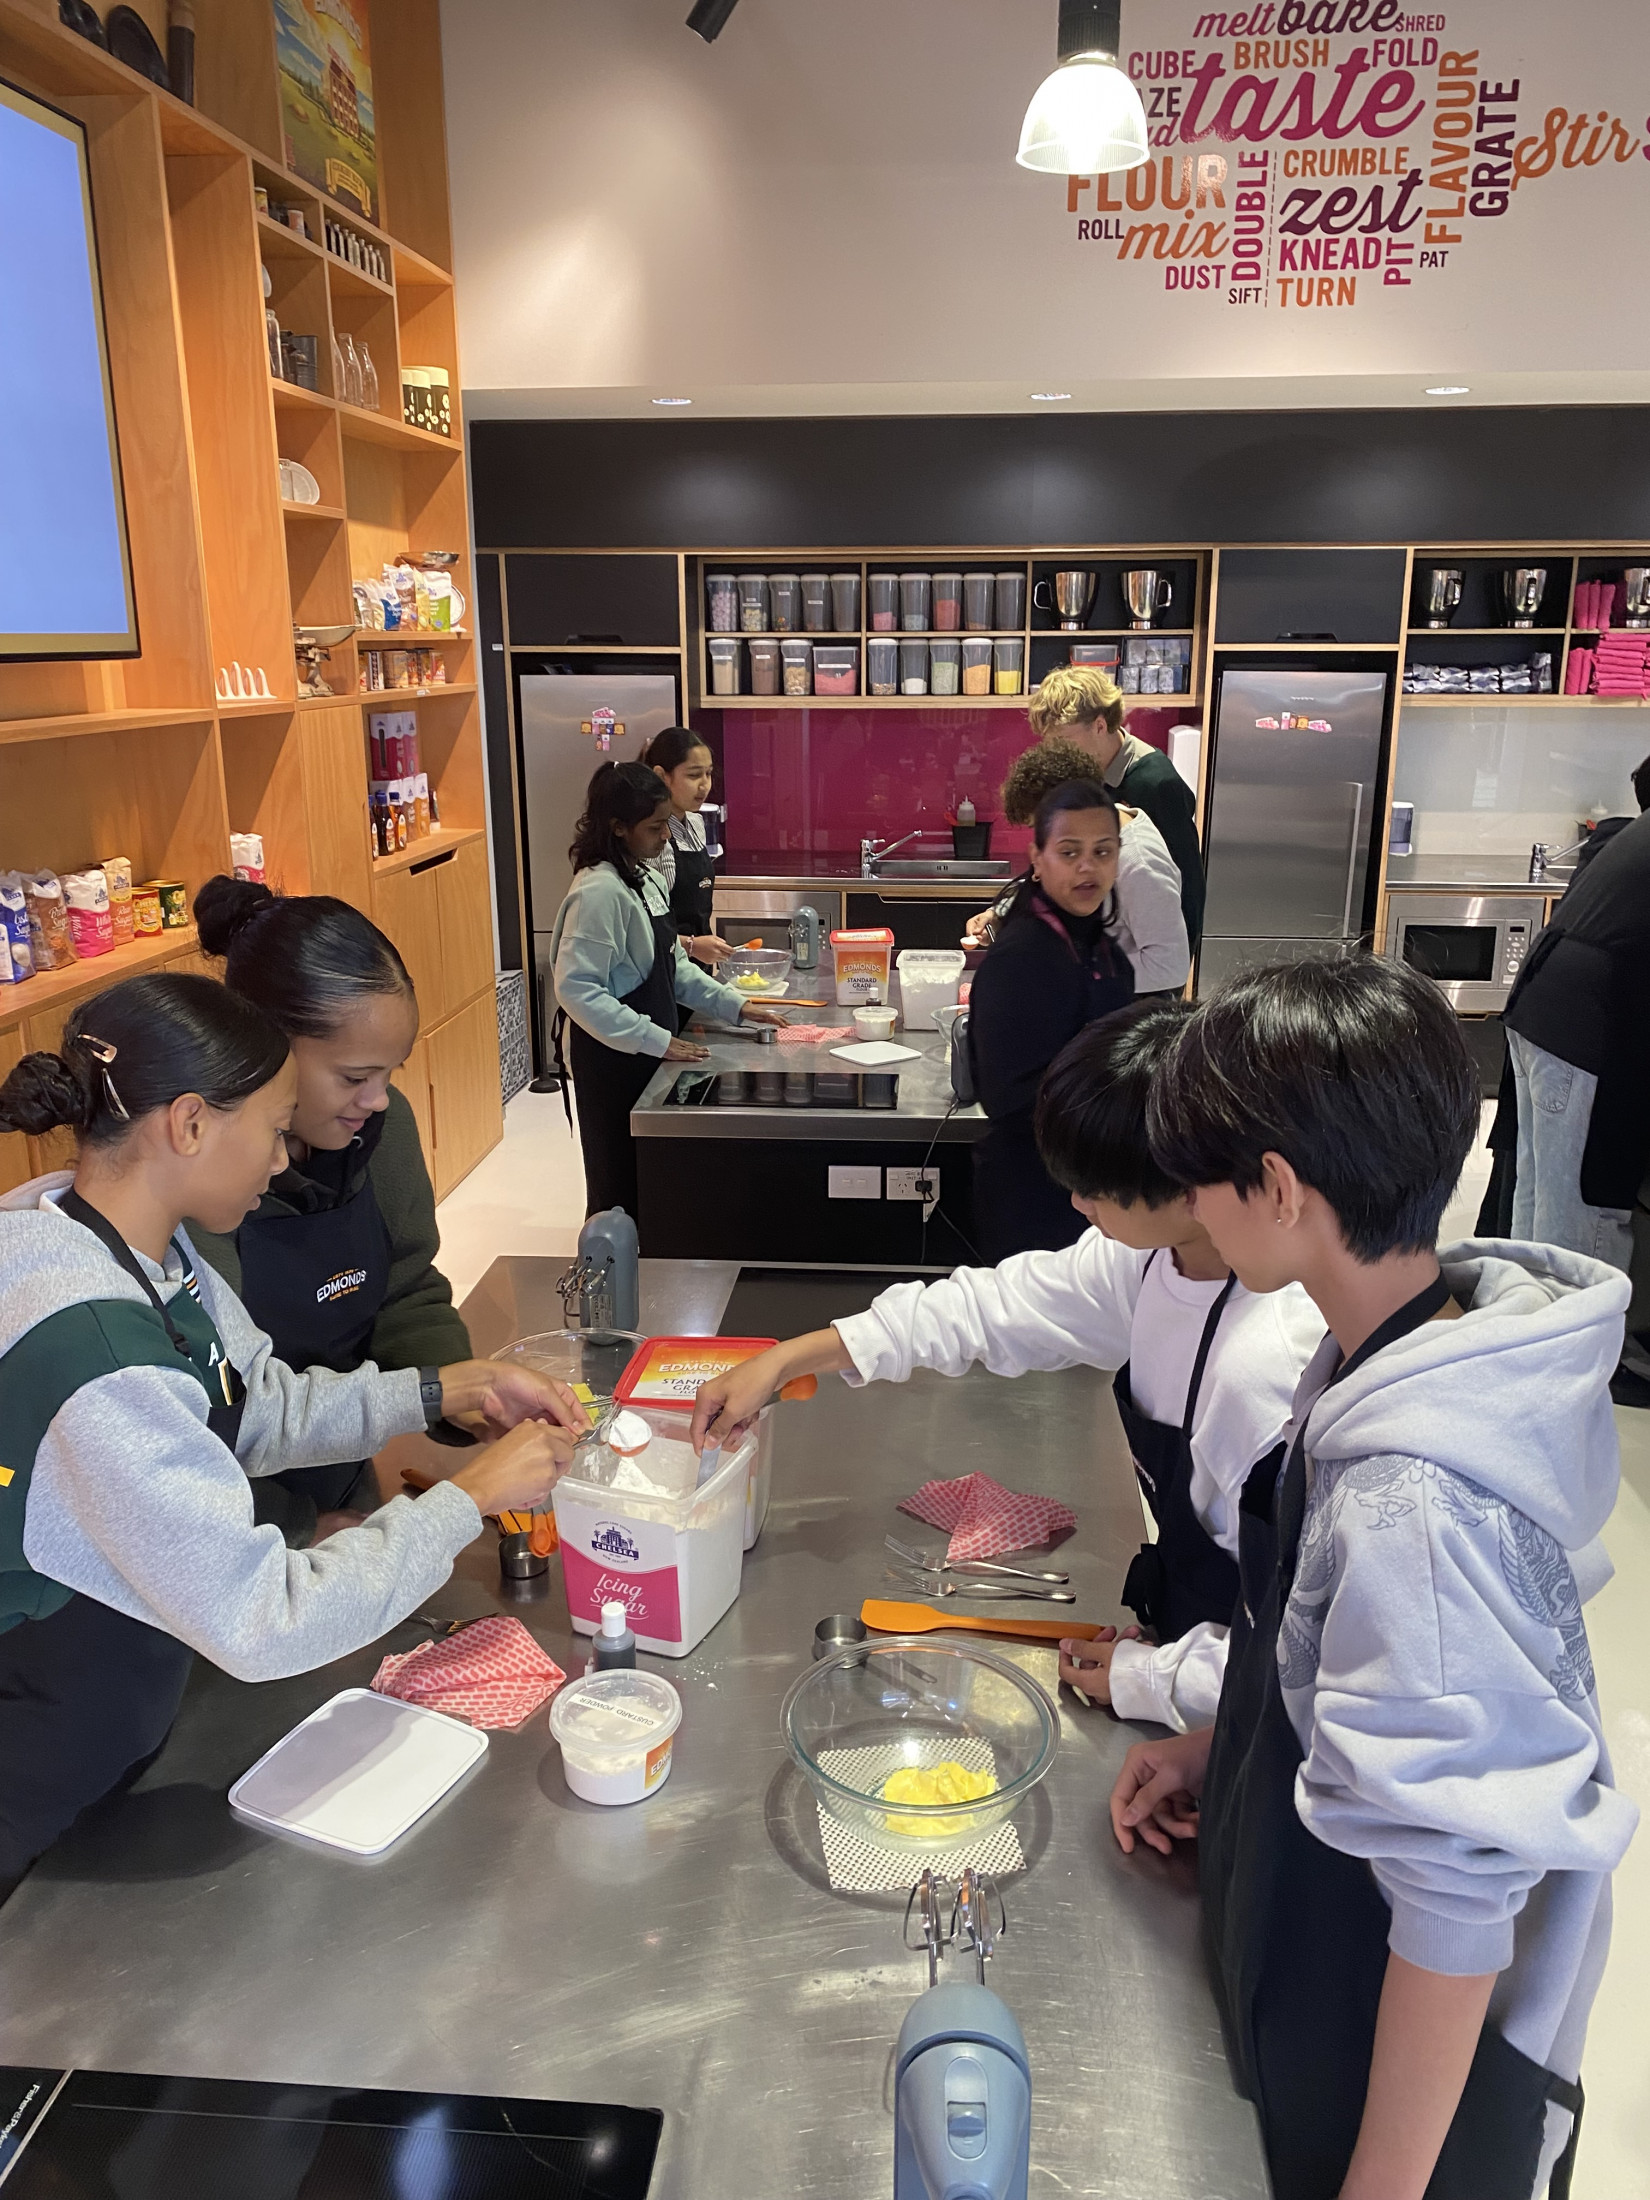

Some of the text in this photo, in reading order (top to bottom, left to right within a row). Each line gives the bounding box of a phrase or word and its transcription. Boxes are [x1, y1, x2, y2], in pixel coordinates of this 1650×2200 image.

[1193, 2, 1276, 38] melt
[1395, 14, 1446, 32] SHRED
[1128, 50, 1196, 80] CUBE
[1234, 38, 1330, 70] BRUSH
[1372, 36, 1439, 68] FOLD
[1179, 47, 1426, 144] taste
[1283, 146, 1410, 178] CRUMBLE
[1424, 49, 1479, 244] FLAVOUR
[1469, 79, 1520, 217] GRATE
[1510, 106, 1641, 191] Stir
[1067, 154, 1228, 213] FLOUR
[1231, 150, 1269, 281] DOUBLE
[1278, 168, 1424, 236] zest
[1078, 218, 1125, 240] ROLL
[1116, 209, 1230, 260] mix
[1279, 237, 1382, 272] KNEAD
[1383, 237, 1415, 286] PIT
[1419, 250, 1449, 268] PAT
[1165, 264, 1226, 290] DUST
[1276, 276, 1357, 308] TURN
[1228, 287, 1262, 304] SIFT
[843, 962, 881, 973] EDMONDS
[316, 1269, 367, 1303] EDMONDS
[595, 1542, 634, 1557] CHELSEA
[589, 1587, 648, 1616] Suar
[596, 1573, 643, 1602] Icing
[579, 1697, 654, 1727] CUSTARD POWDER
